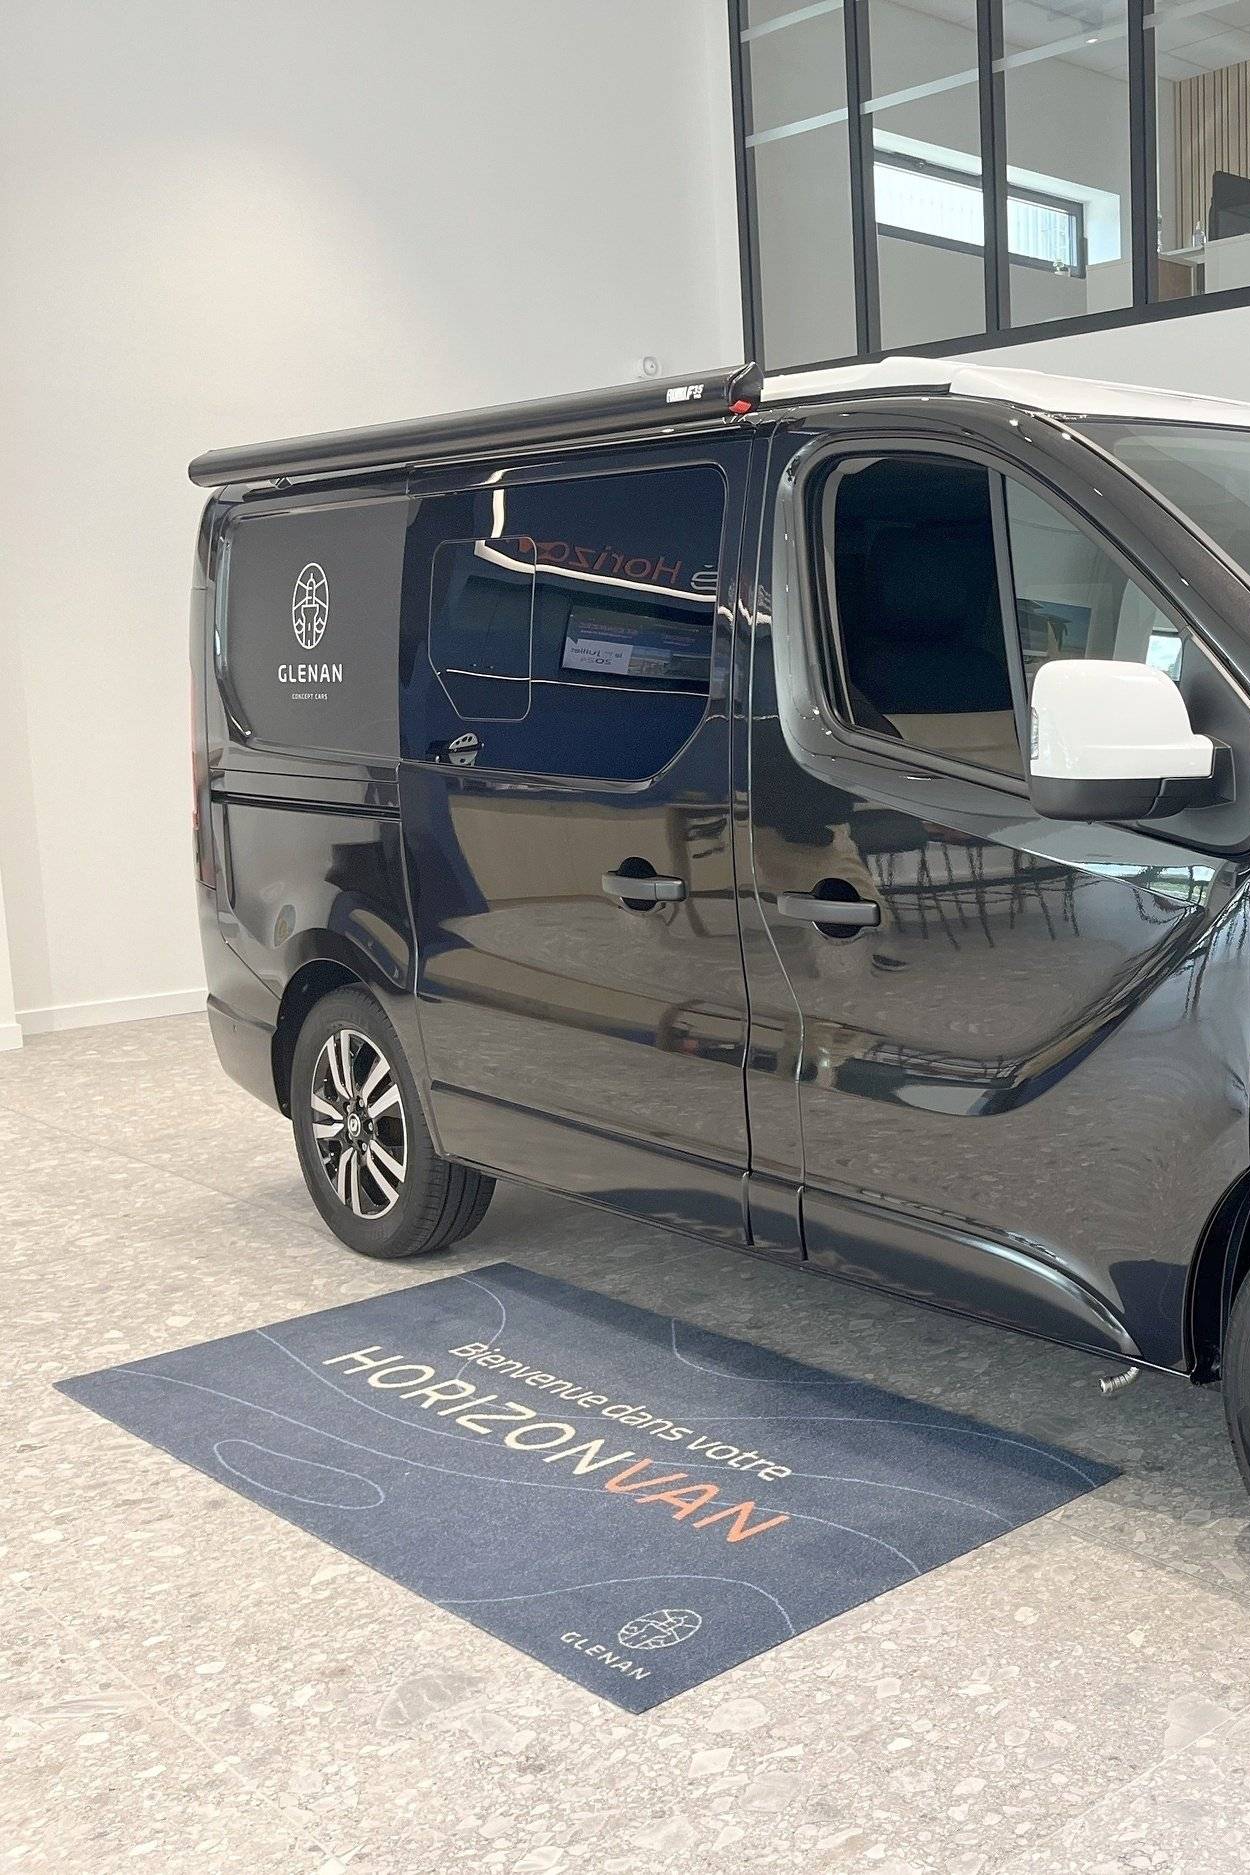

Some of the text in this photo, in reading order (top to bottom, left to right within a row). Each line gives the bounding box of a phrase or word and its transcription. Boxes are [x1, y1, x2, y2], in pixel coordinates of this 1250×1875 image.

[278, 664, 343, 683] GLENAN
[291, 693, 314, 701] CONCEPT
[449, 1342, 792, 1482] Bienvenue dans votre
[560, 1631, 652, 1681] GLENAN
